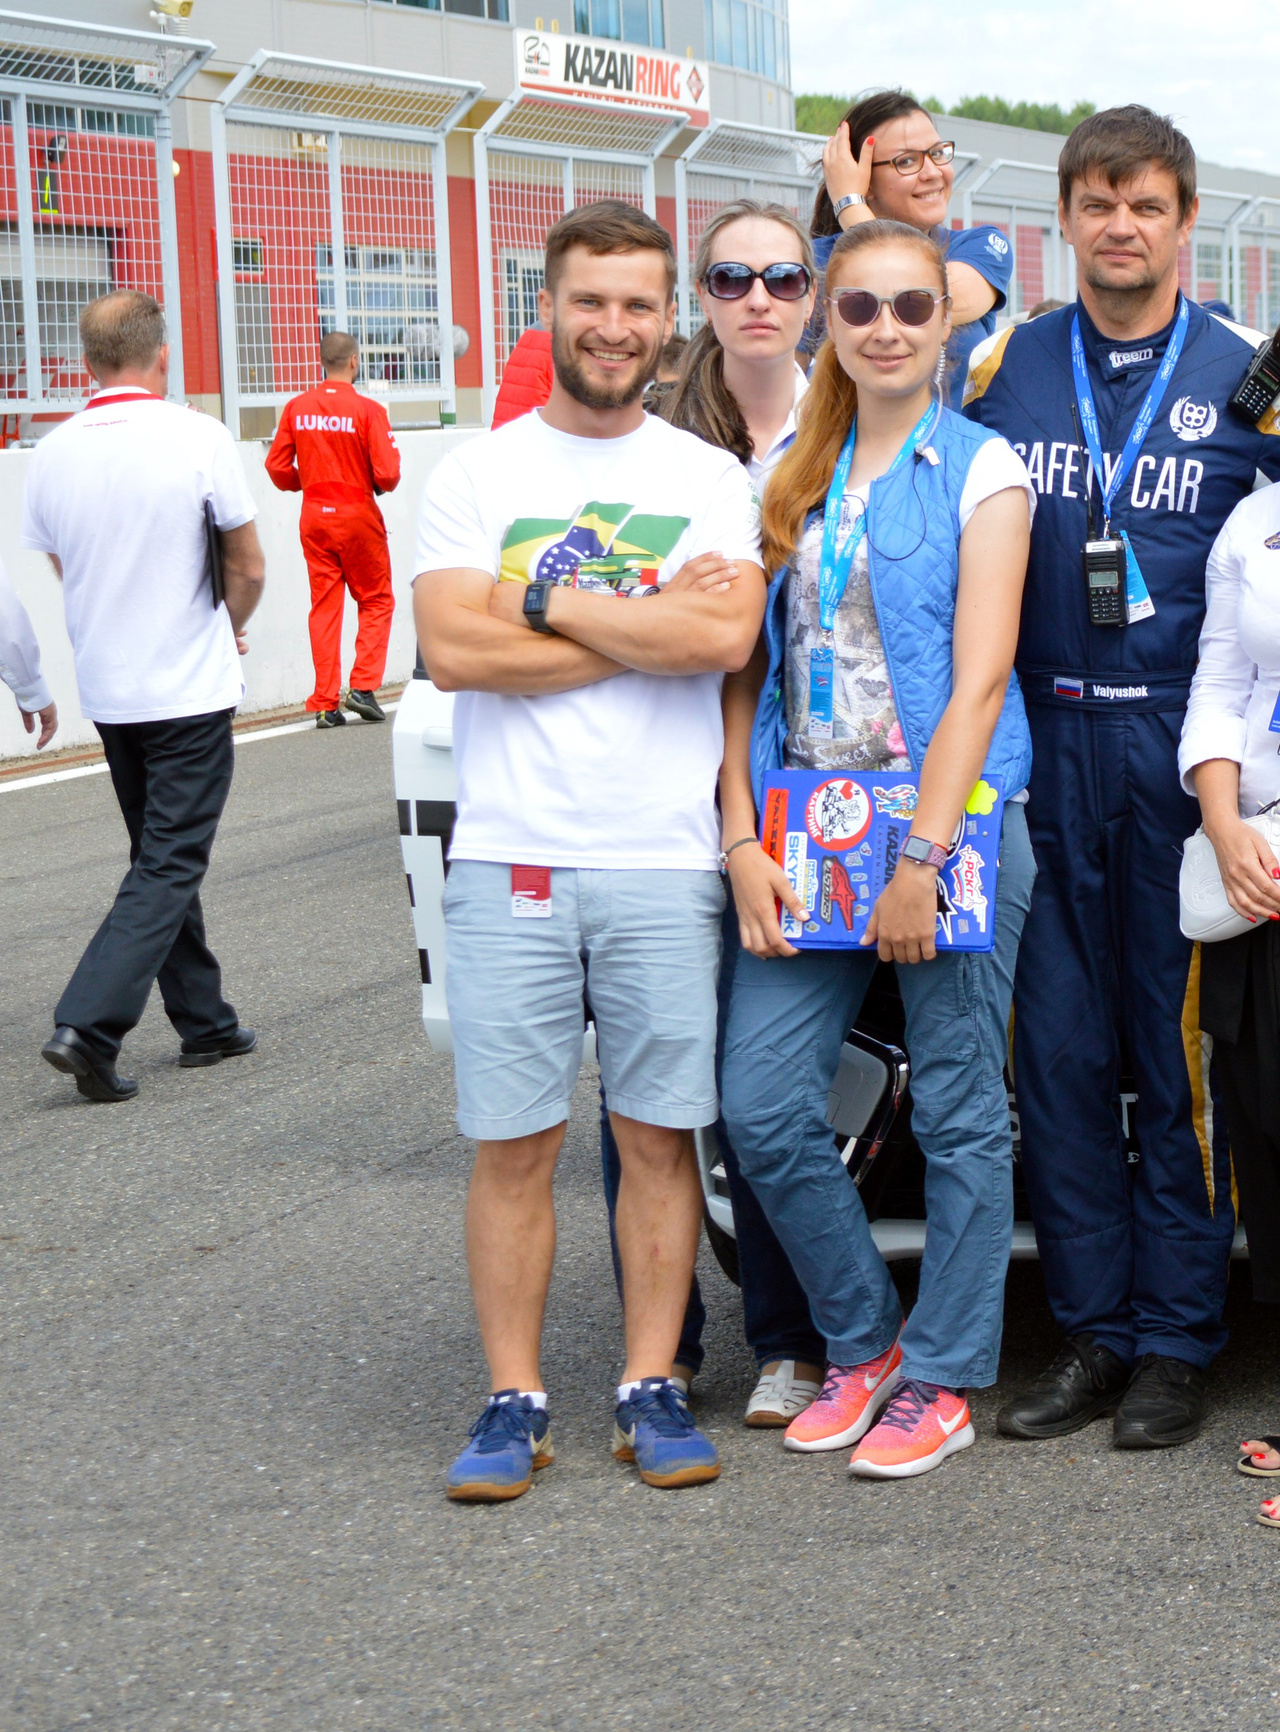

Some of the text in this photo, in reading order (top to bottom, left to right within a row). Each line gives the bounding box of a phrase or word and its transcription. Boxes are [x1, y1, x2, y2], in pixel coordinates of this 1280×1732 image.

[1109, 347, 1153, 368] freem
[296, 414, 356, 433] LUKOIL
[1131, 455, 1204, 514] CAR
[1092, 684, 1149, 699] Valyushok
[807, 791, 822, 838] КАРТИНГ
